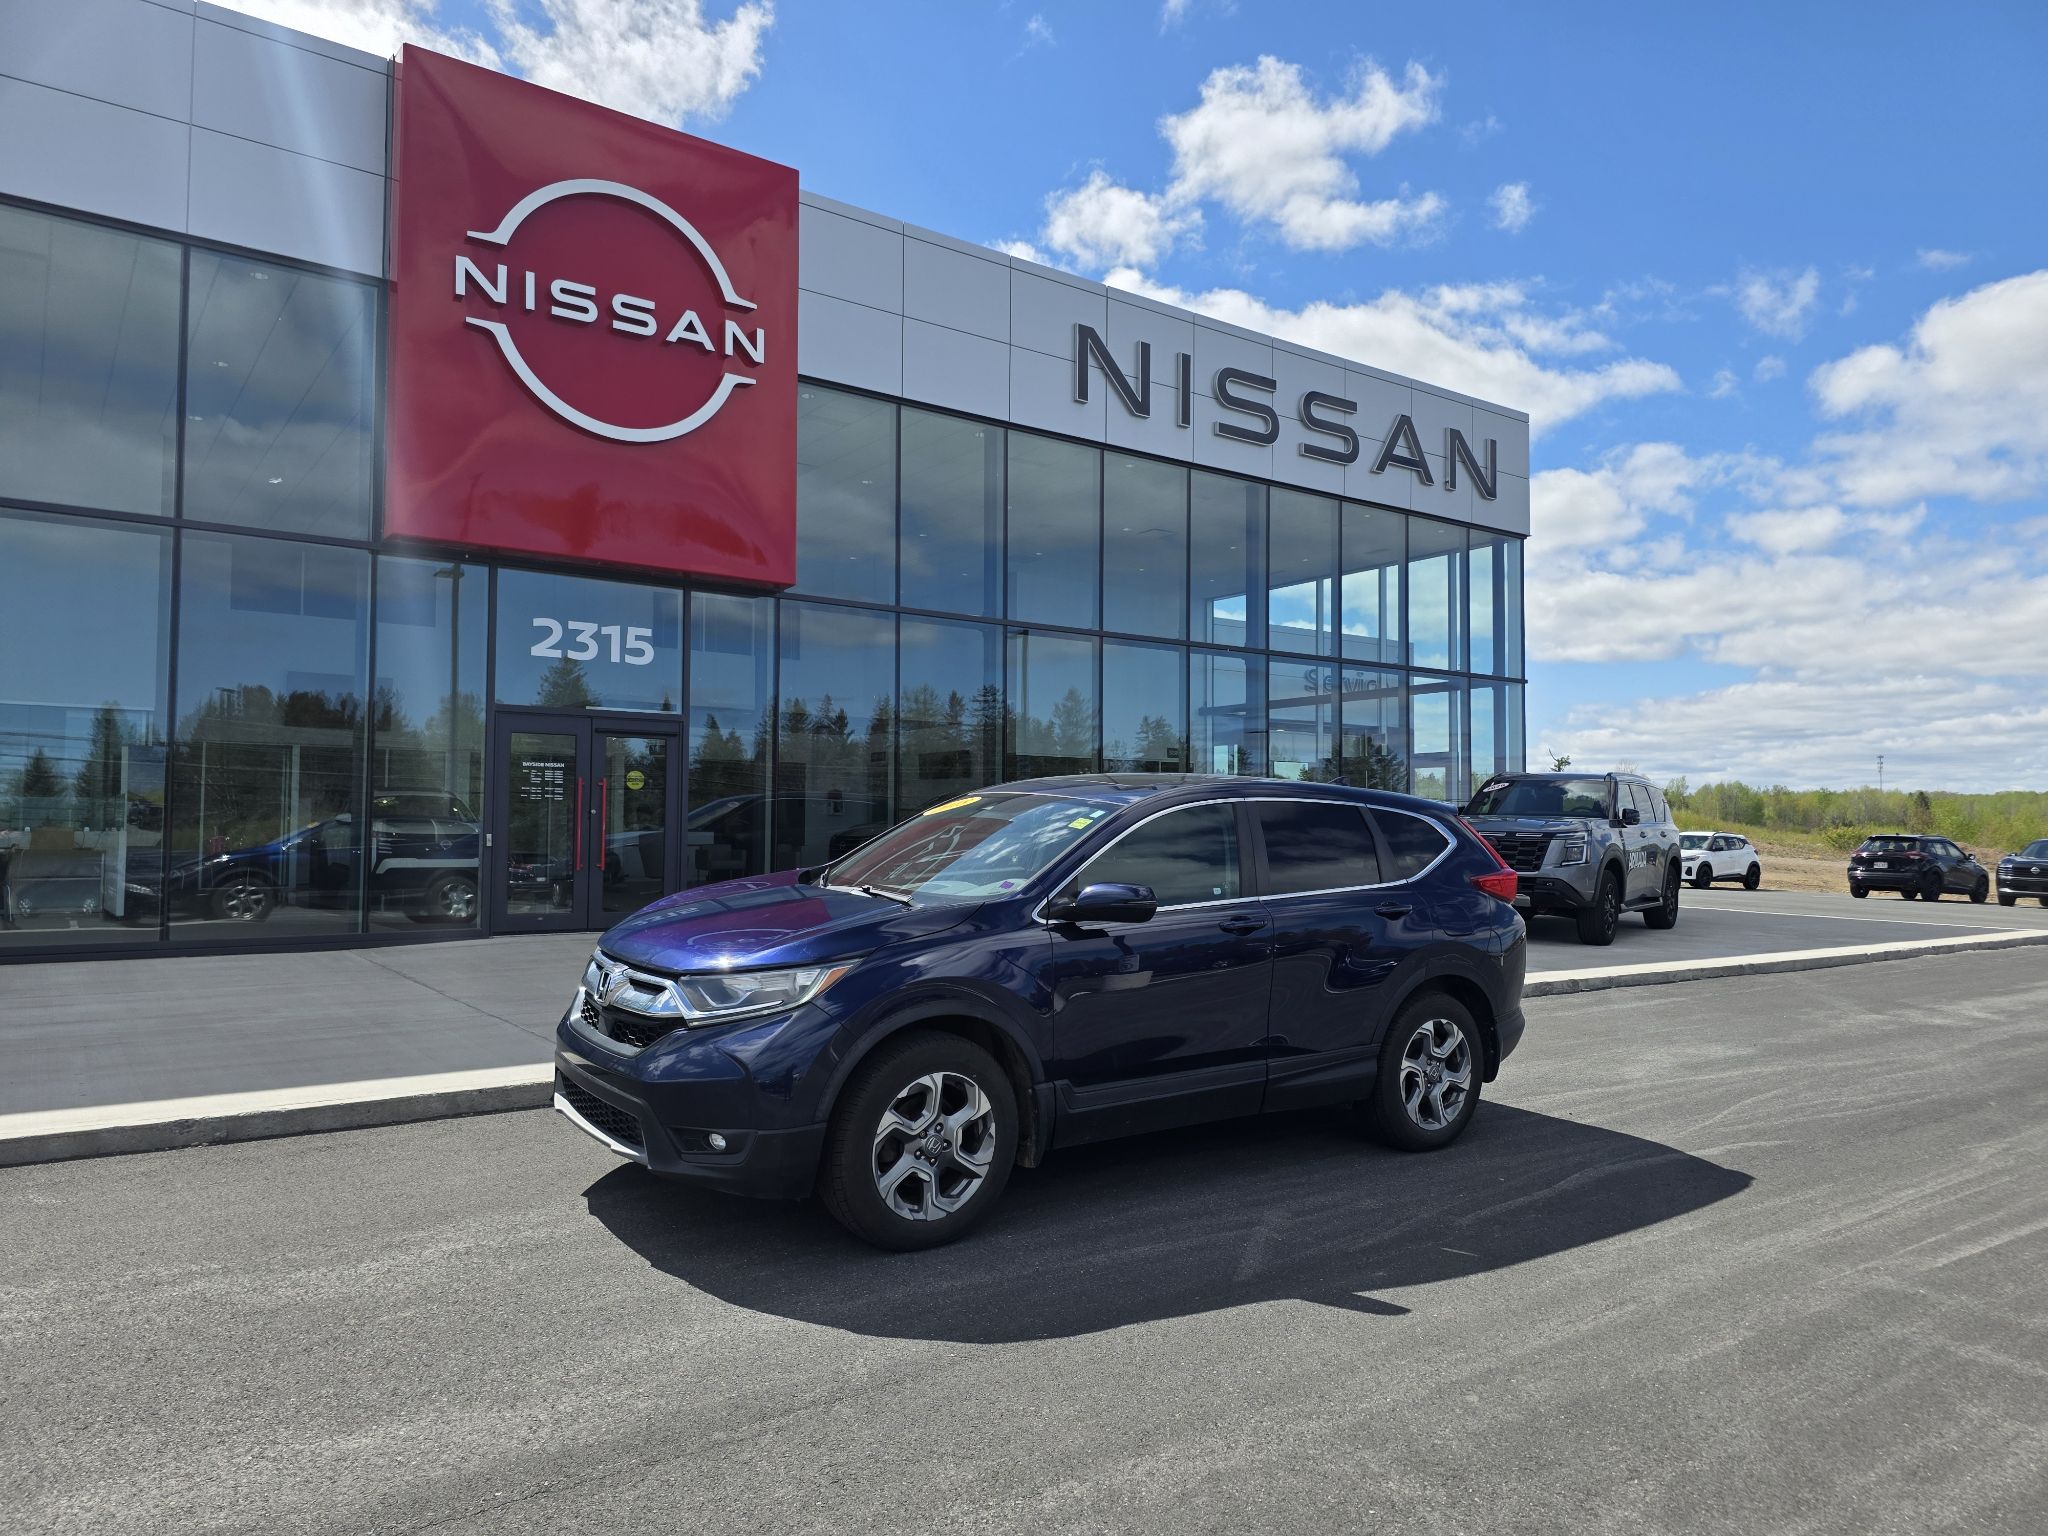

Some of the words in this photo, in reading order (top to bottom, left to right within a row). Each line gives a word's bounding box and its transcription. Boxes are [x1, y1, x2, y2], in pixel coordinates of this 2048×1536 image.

[454, 254, 766, 365] NISSAN
[1073, 322, 1498, 501] NISSAN
[530, 617, 655, 666] 2315
